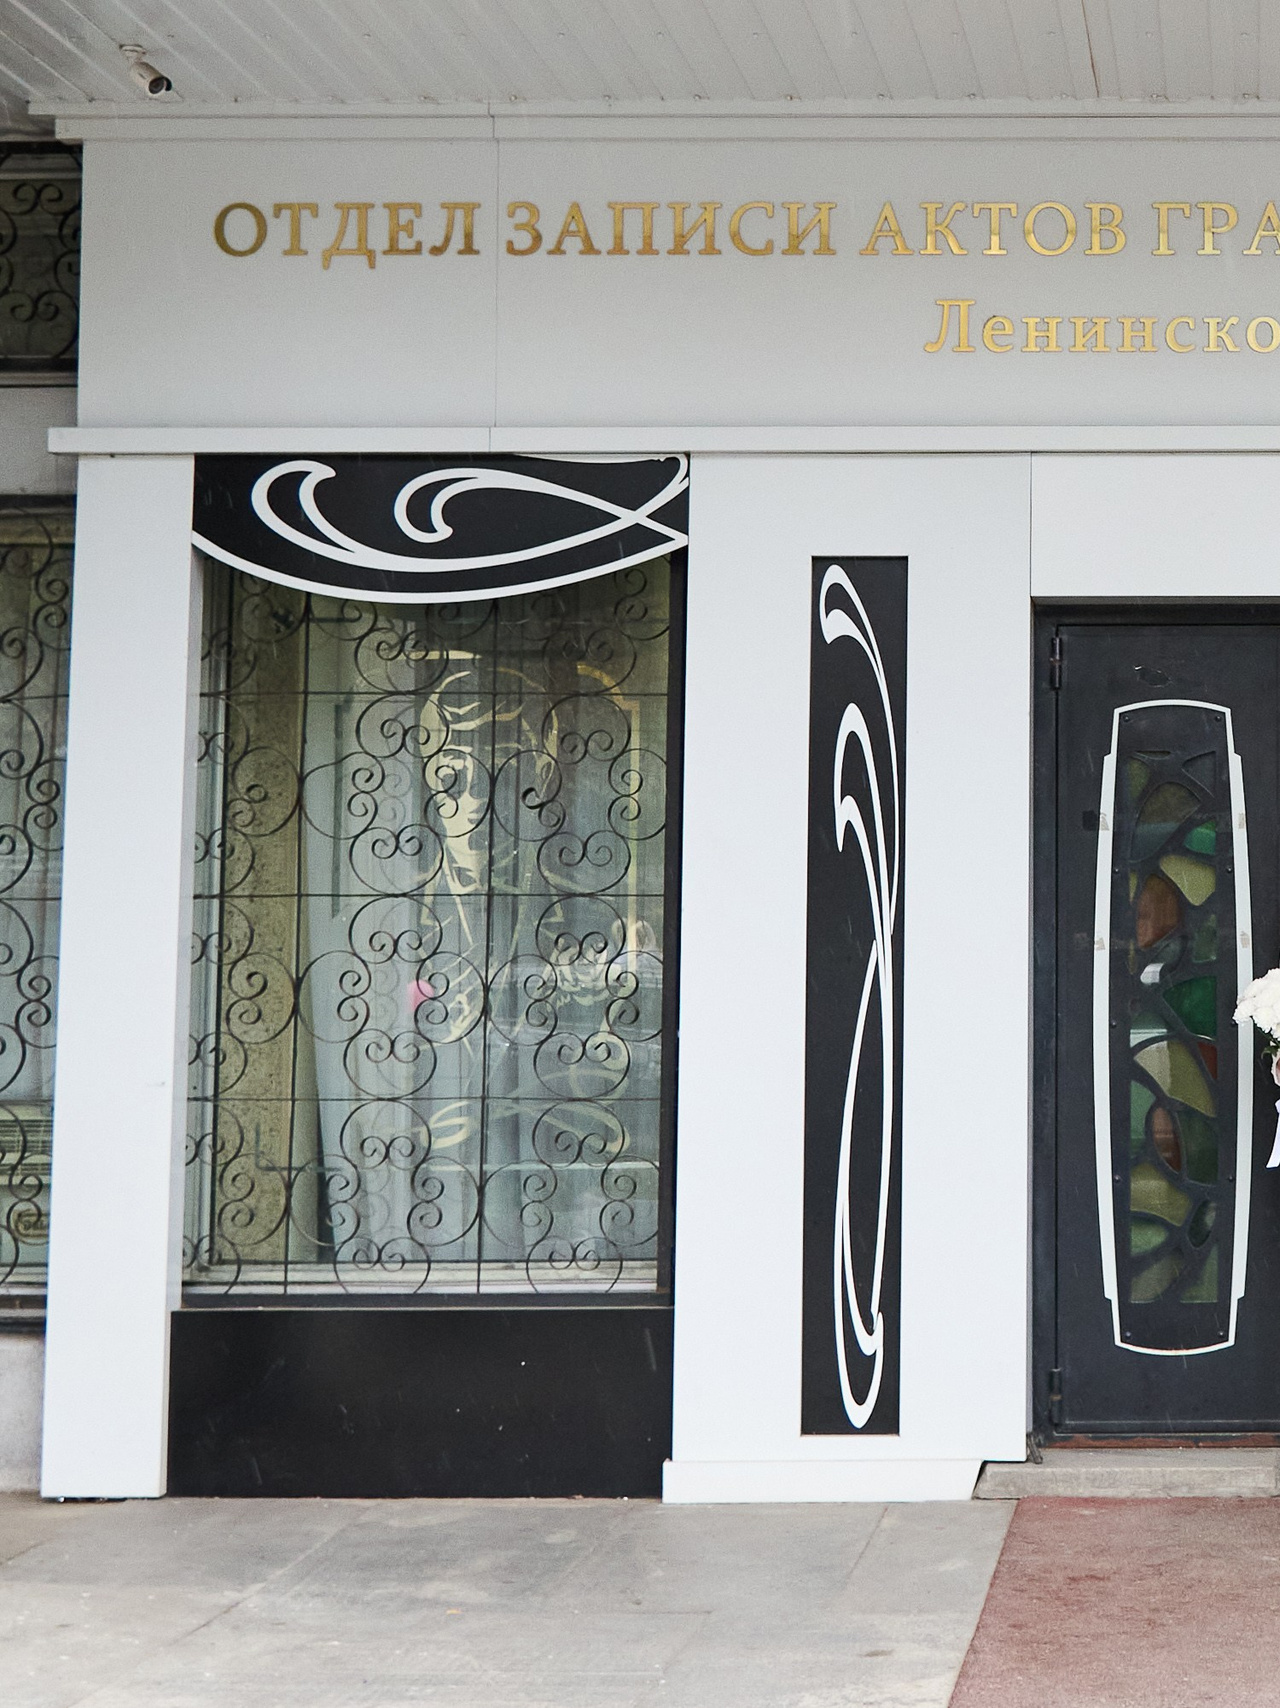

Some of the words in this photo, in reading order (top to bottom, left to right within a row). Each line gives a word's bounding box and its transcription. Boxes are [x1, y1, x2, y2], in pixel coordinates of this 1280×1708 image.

[212, 201, 480, 270] ОТДЕЛ
[505, 200, 837, 257] ЗАПИСИ
[859, 201, 1127, 257] АКТОВ
